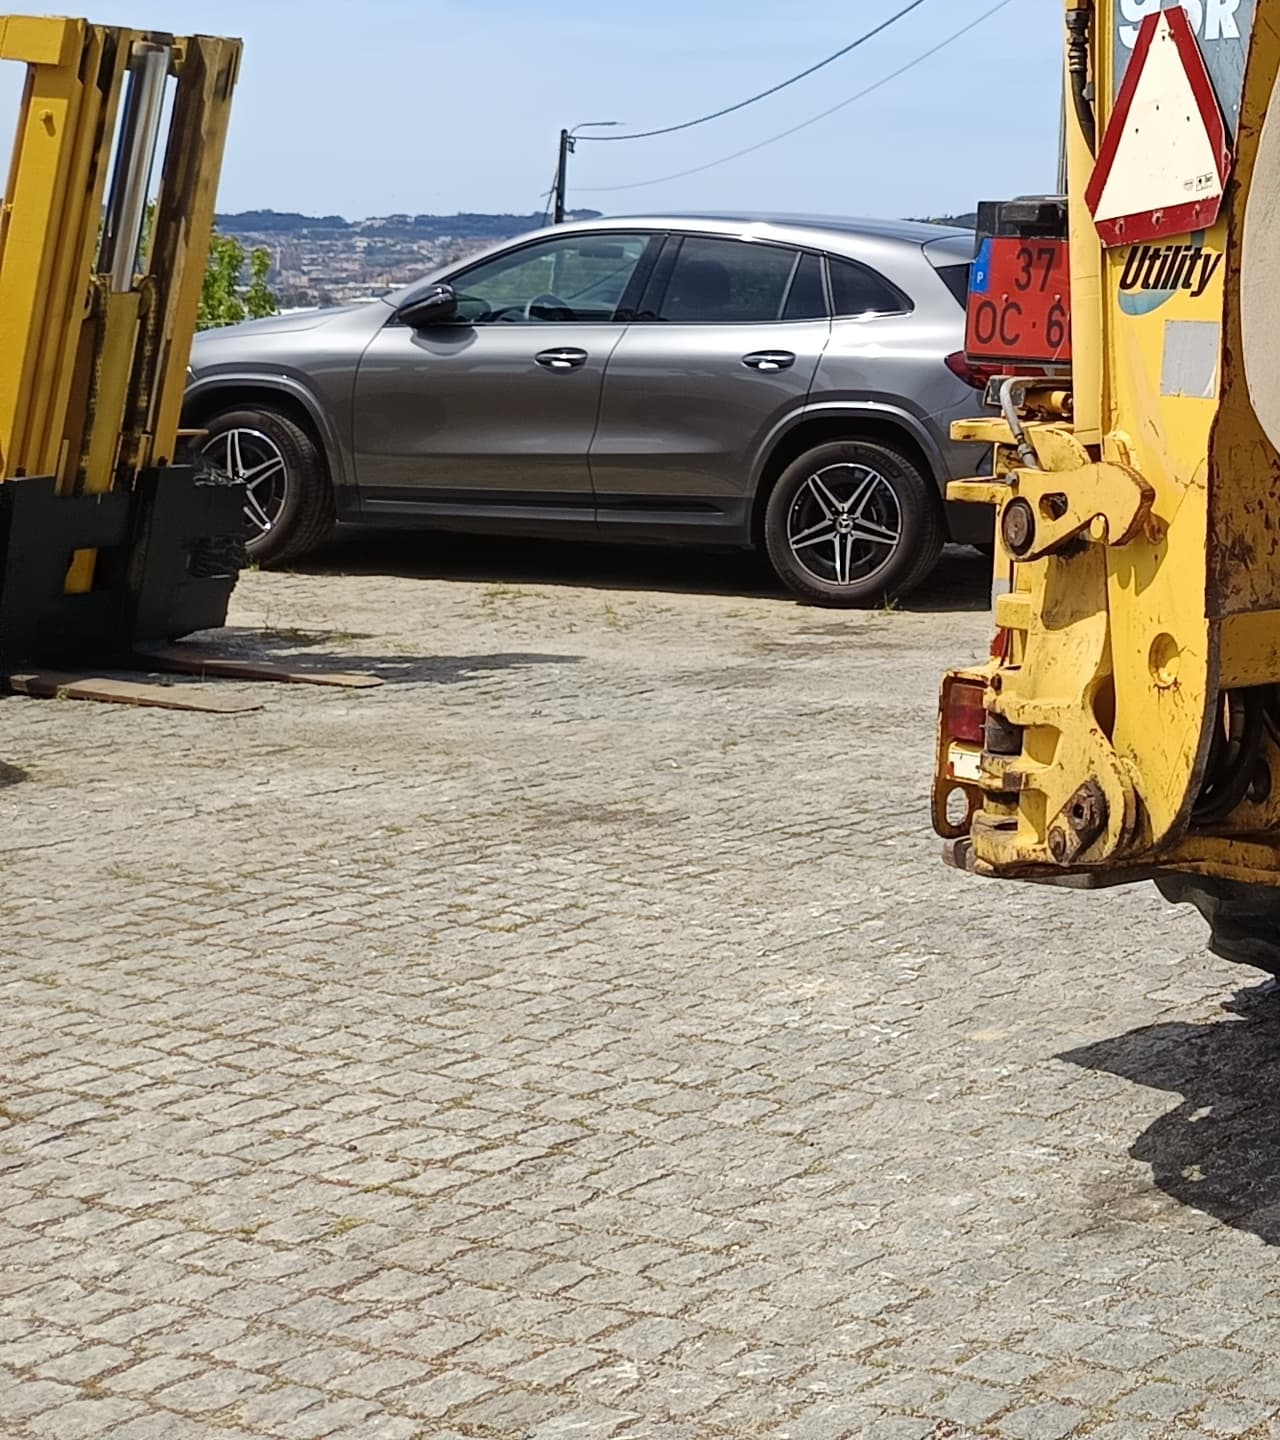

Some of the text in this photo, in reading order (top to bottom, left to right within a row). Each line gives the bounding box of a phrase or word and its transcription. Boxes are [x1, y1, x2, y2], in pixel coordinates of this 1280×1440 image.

[976, 271, 984, 284] P
[1014, 246, 1056, 292] 37
[1119, 244, 1223, 298] Utility
